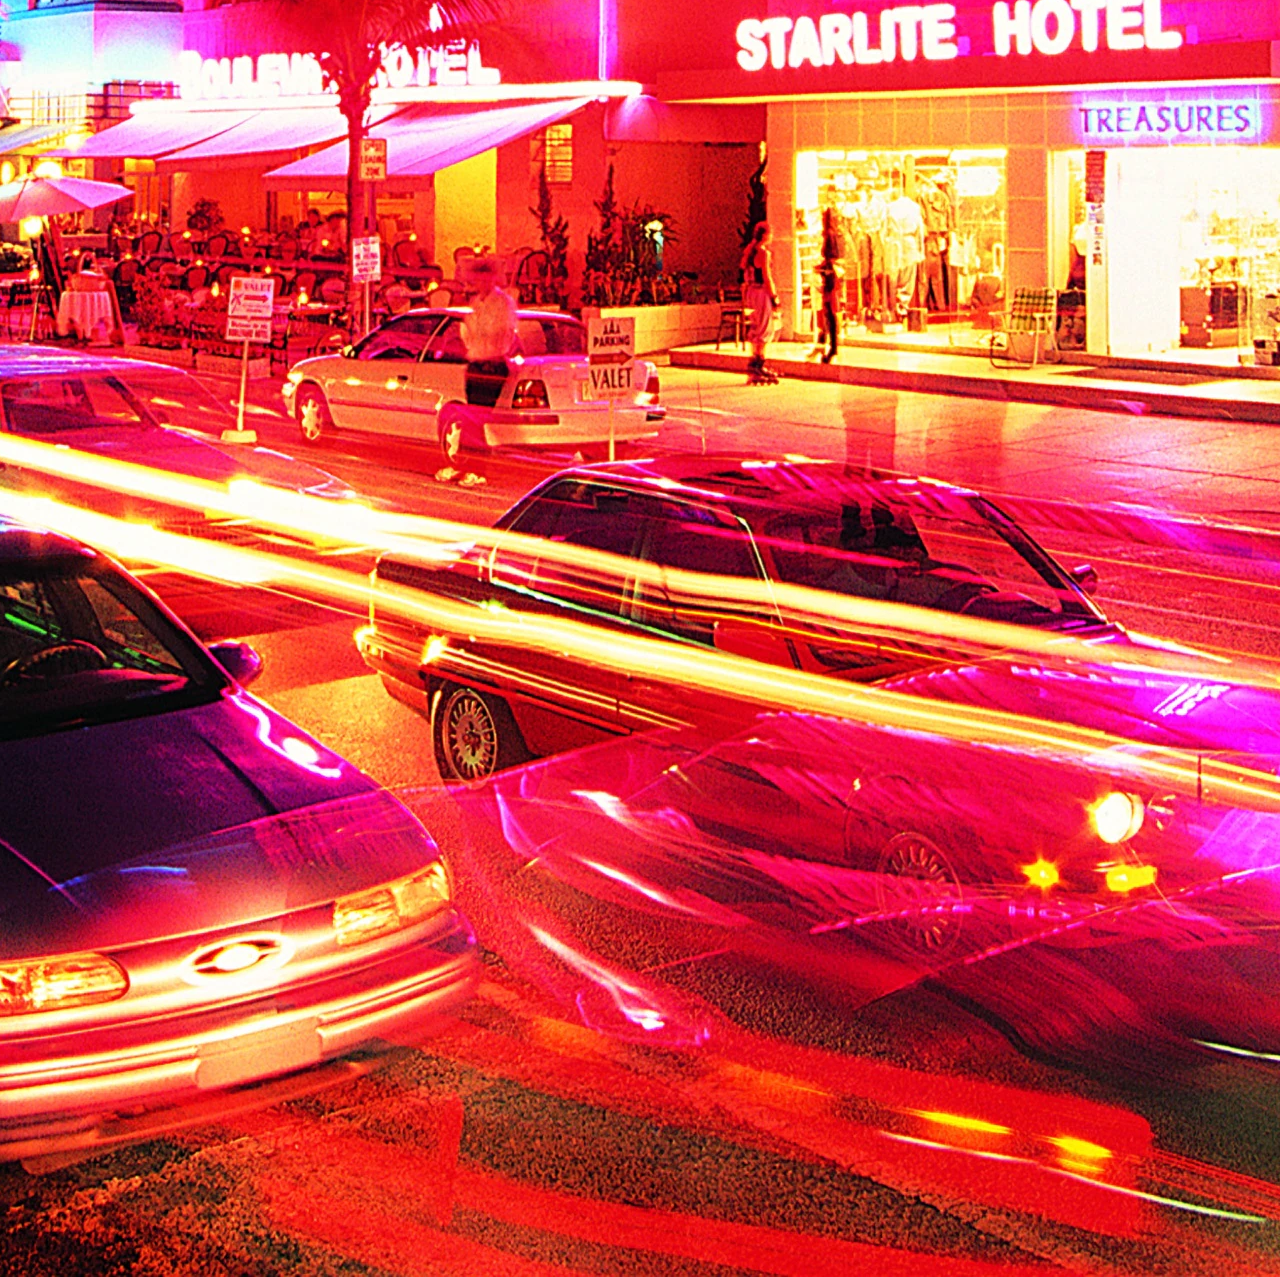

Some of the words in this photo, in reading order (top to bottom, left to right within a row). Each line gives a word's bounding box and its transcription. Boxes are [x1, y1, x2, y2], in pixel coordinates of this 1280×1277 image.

[736, 4, 958, 71] STARLITE
[1079, 105, 1251, 133] TREASURES
[603, 319, 620, 335] AAA
[593, 334, 631, 347] PARKING
[591, 367, 633, 390] VALET
